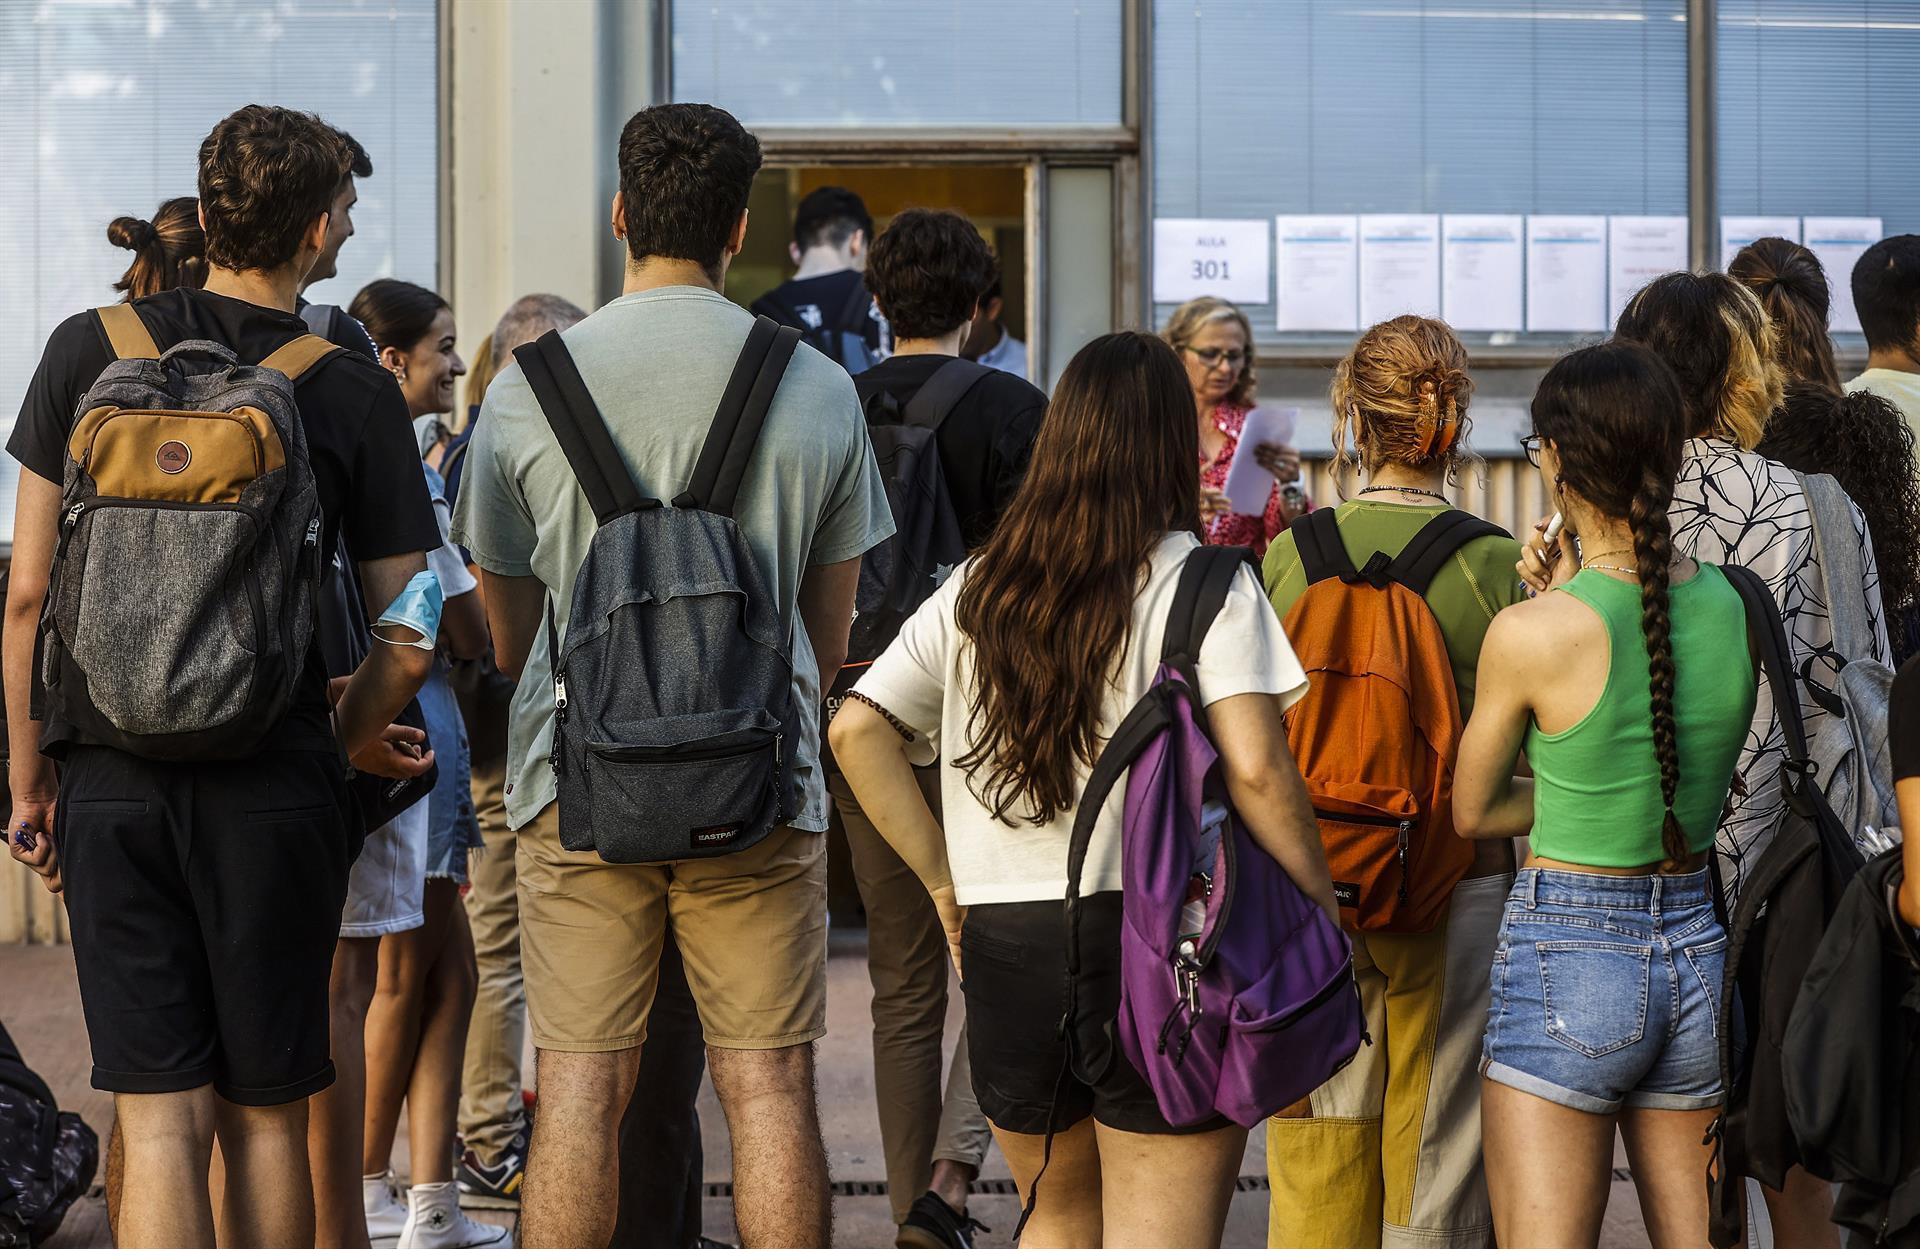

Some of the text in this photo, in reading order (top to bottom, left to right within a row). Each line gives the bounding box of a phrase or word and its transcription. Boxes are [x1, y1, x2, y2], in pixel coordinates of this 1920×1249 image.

[1196, 236, 1227, 248] AULA
[1192, 260, 1231, 280] 301
[698, 830, 738, 841] EASTPAK
